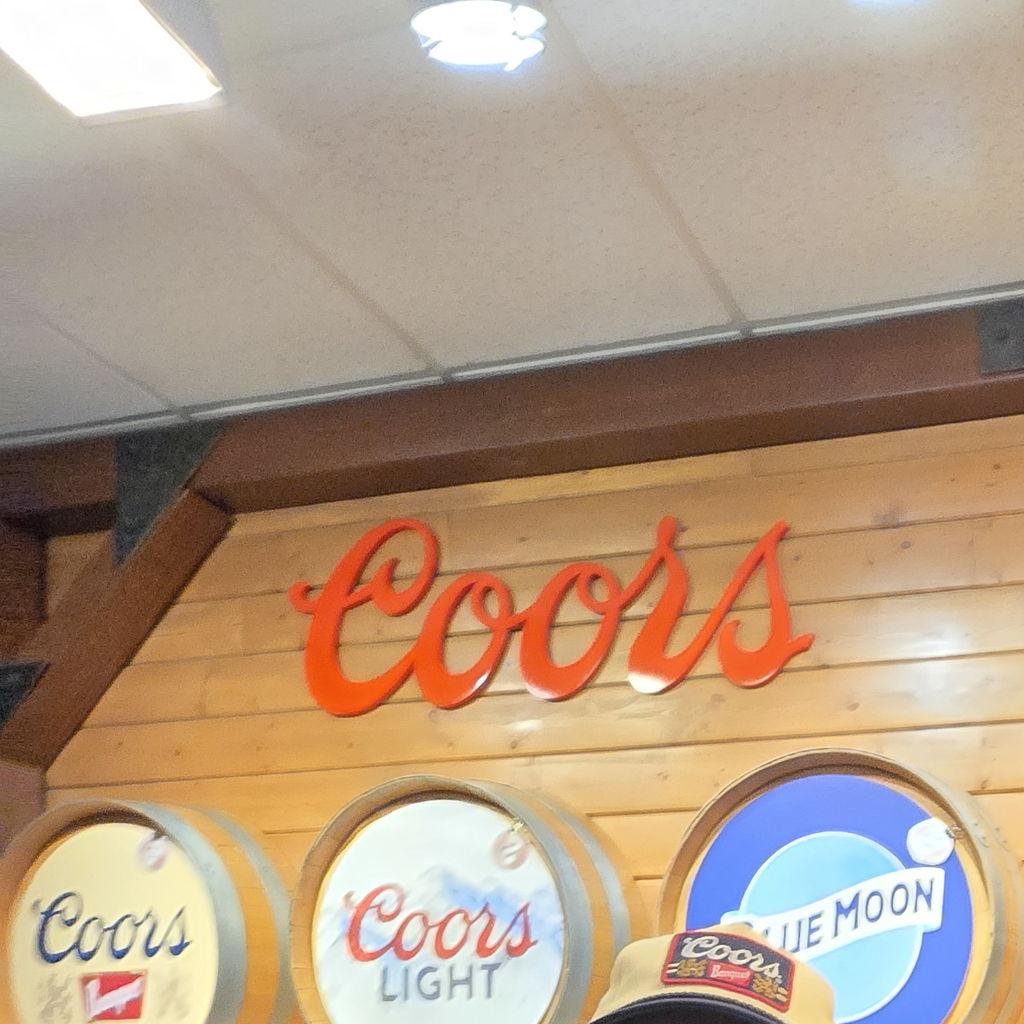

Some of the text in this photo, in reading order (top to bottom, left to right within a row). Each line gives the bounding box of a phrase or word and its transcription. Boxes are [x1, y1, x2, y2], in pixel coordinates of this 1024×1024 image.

[288, 514, 816, 718] Coors
[30, 890, 192, 964] Coors
[342, 882, 538, 962] Coors
[831, 877, 936, 939] MOON
[379, 962, 502, 1002] LIGHT
[680, 935, 782, 979] Coors
